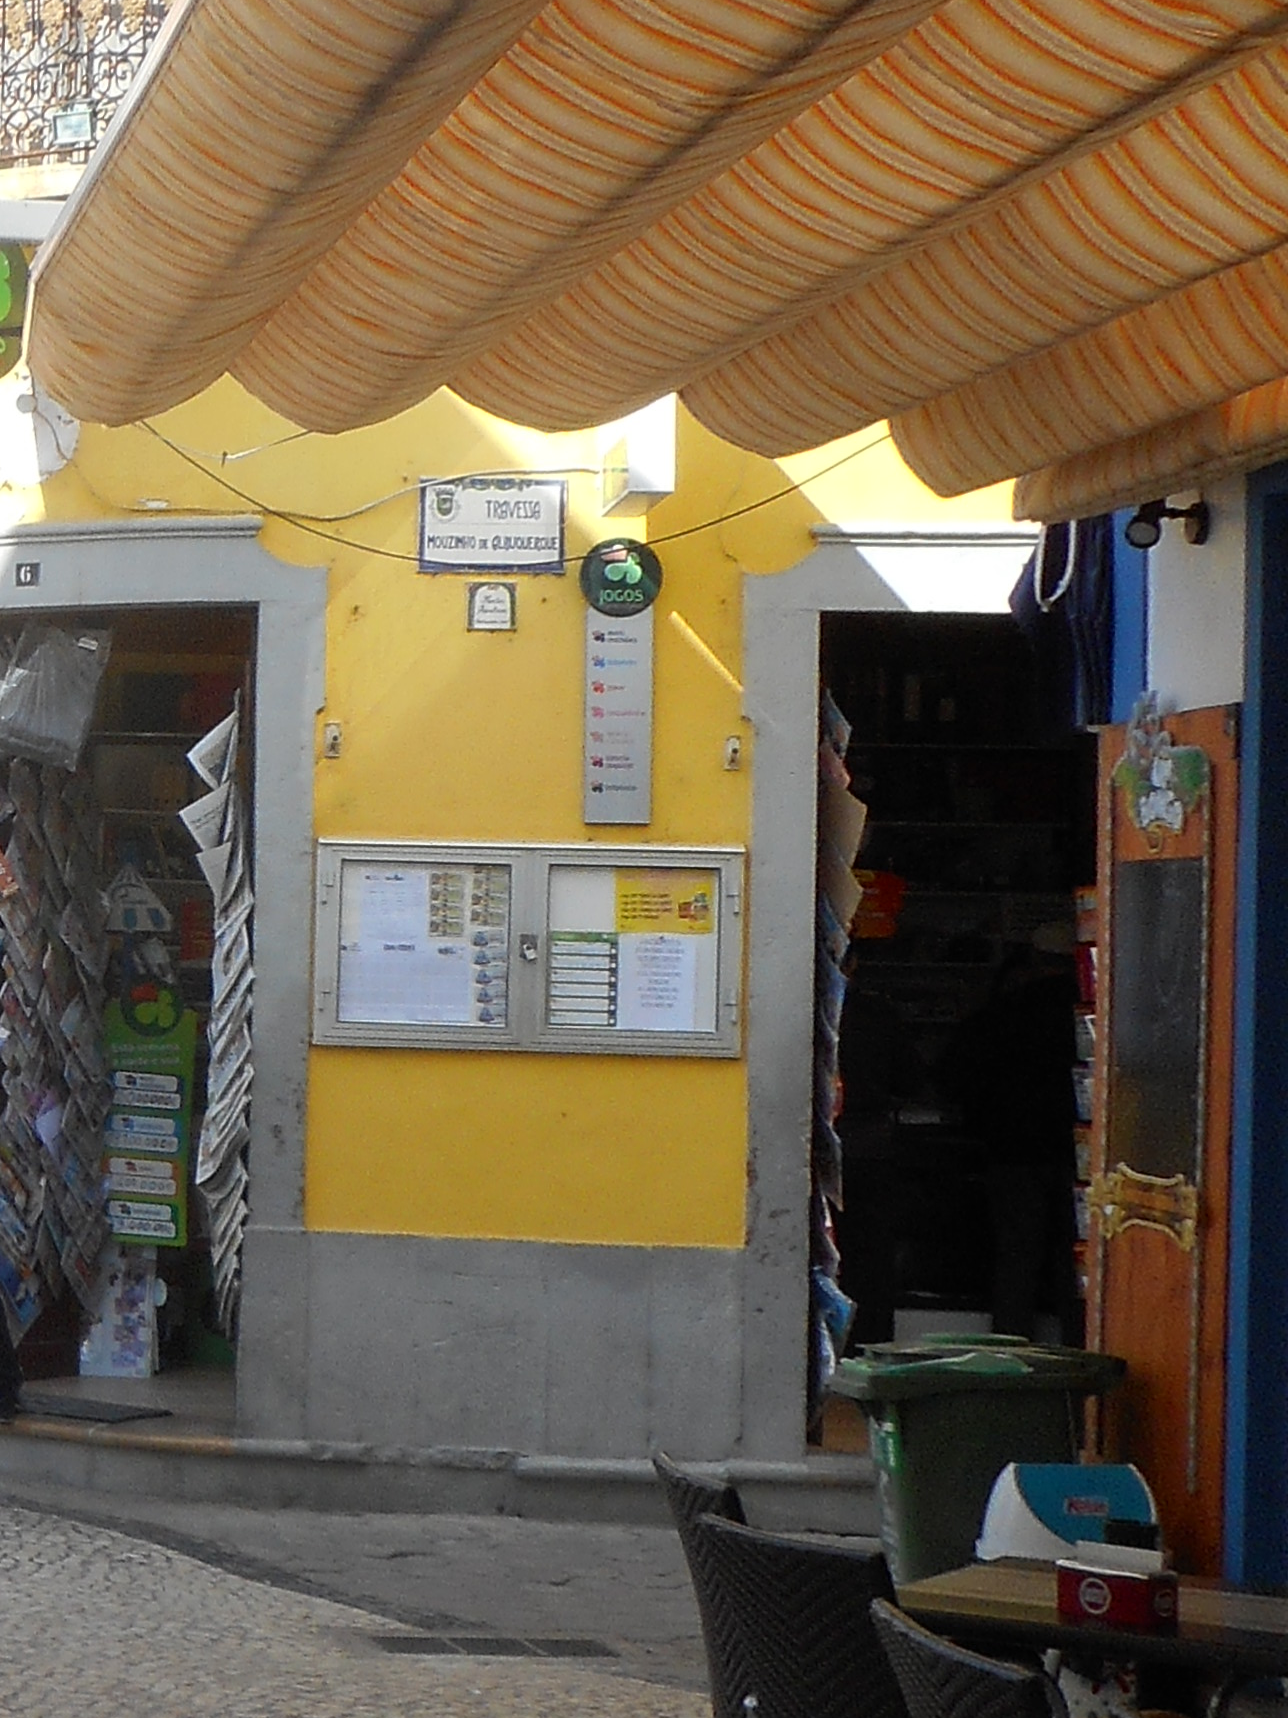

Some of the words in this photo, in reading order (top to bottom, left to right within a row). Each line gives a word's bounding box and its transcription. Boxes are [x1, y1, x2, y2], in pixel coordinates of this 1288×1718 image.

[485, 499, 541, 520] TRAVESSA
[427, 534, 476, 550] MOUZINHO
[491, 534, 558, 552] ALBUQUERQUE
[19, 565, 32, 583] 6
[599, 589, 644, 605] JOGOS
